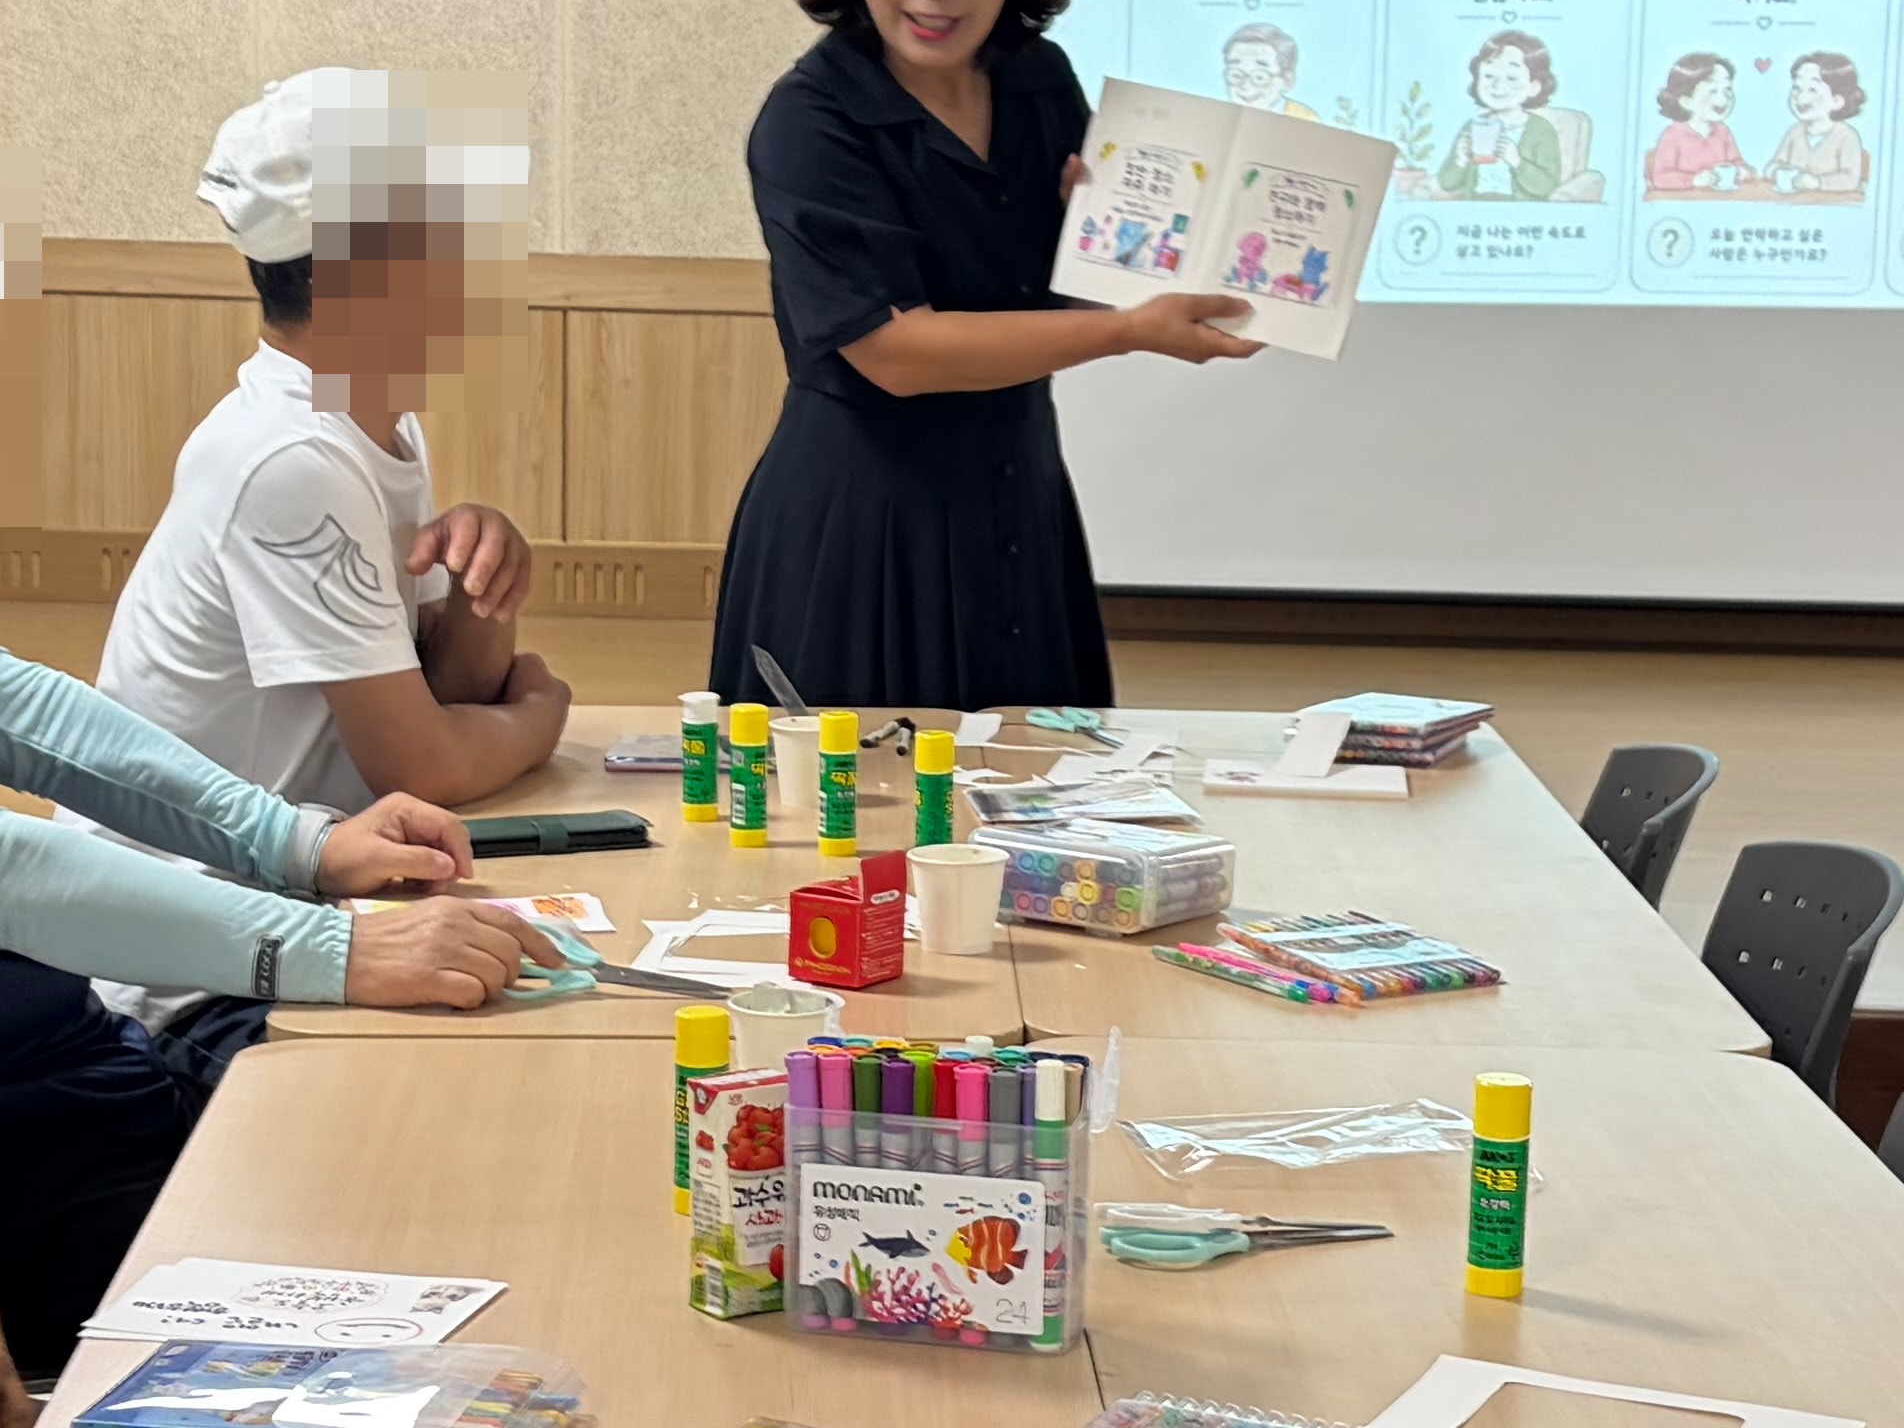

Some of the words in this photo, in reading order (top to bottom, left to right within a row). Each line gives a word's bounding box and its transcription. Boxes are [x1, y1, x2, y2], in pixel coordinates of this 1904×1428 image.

[1409, 225, 1427, 255] ?
[1662, 229, 1679, 257] ?
[996, 1299, 1030, 1324] 24
